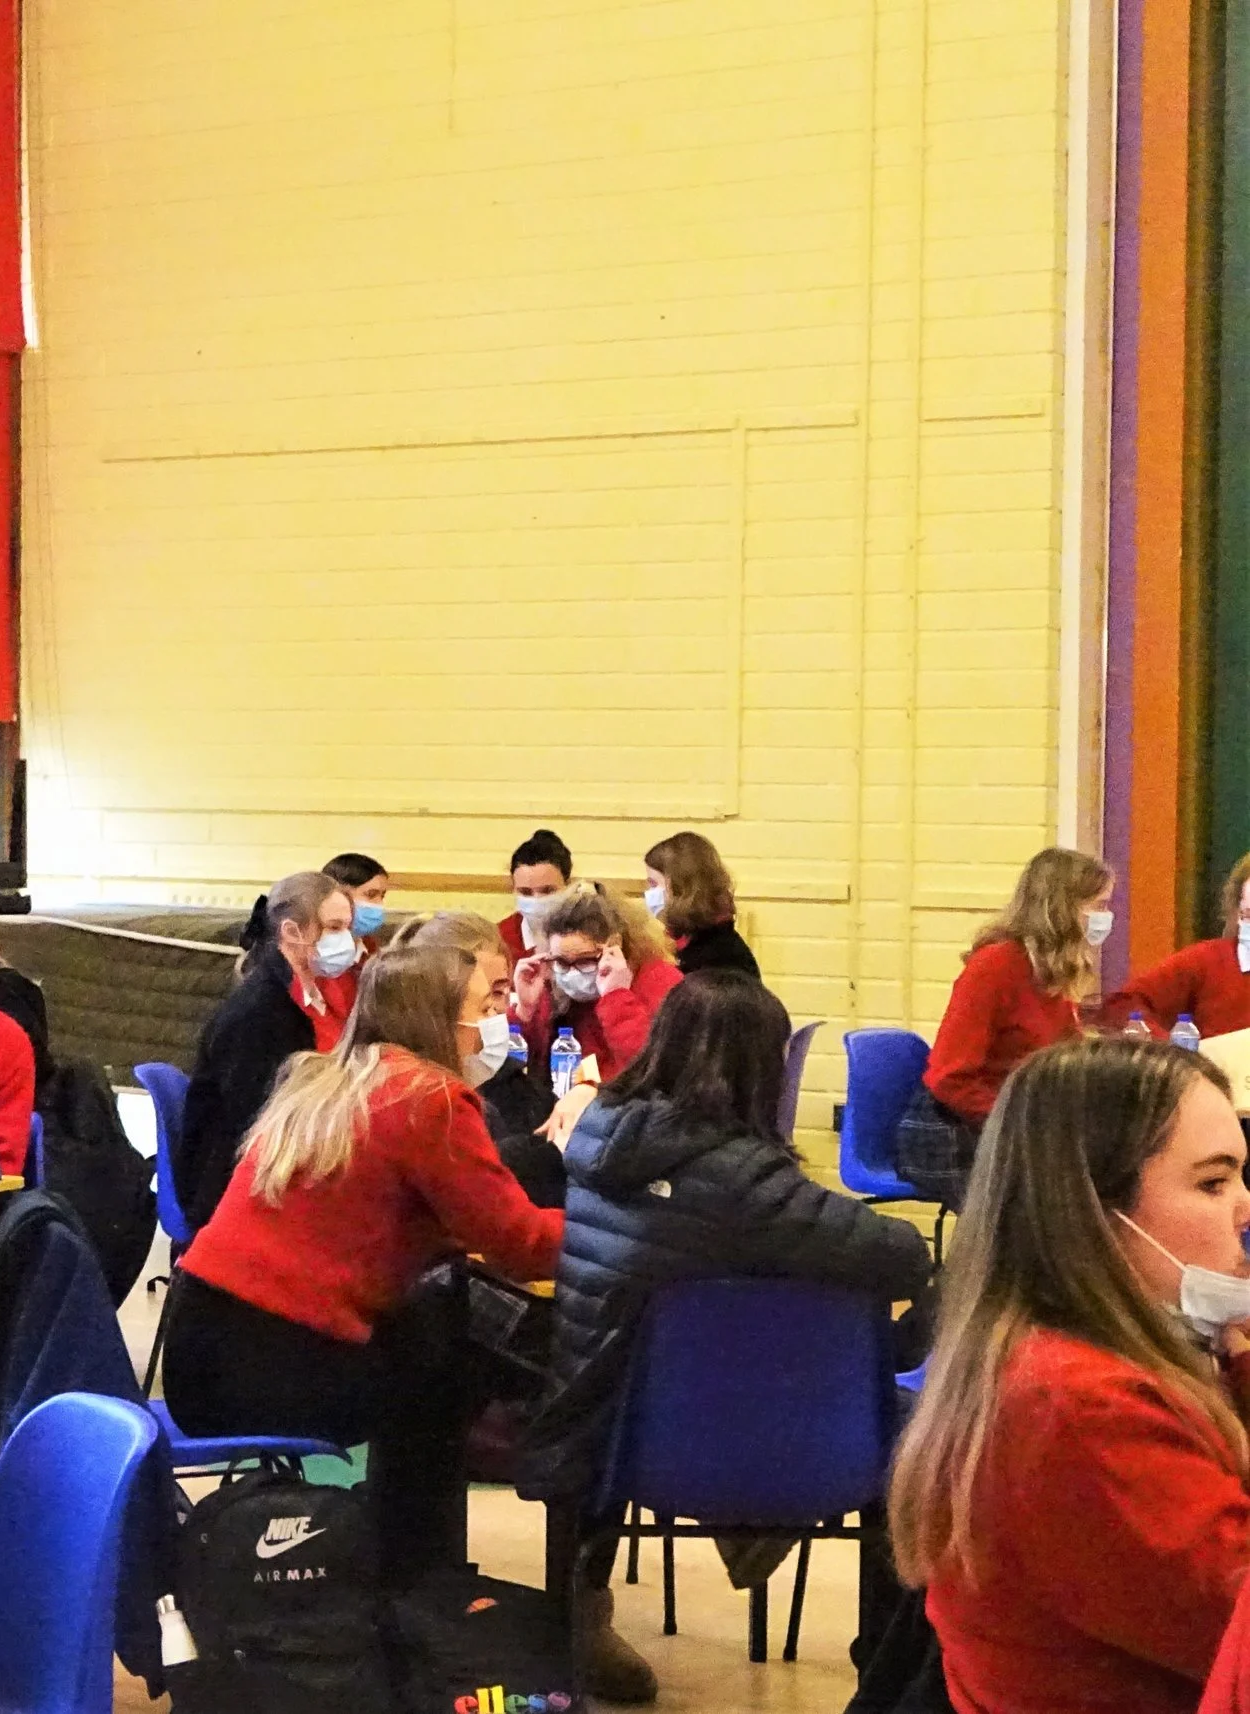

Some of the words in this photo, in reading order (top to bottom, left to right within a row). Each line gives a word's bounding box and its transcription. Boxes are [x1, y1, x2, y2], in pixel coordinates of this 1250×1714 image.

[265, 1516, 312, 1541] NIKE
[253, 1570, 281, 1583] AIR
[286, 1567, 327, 1581] MAX
